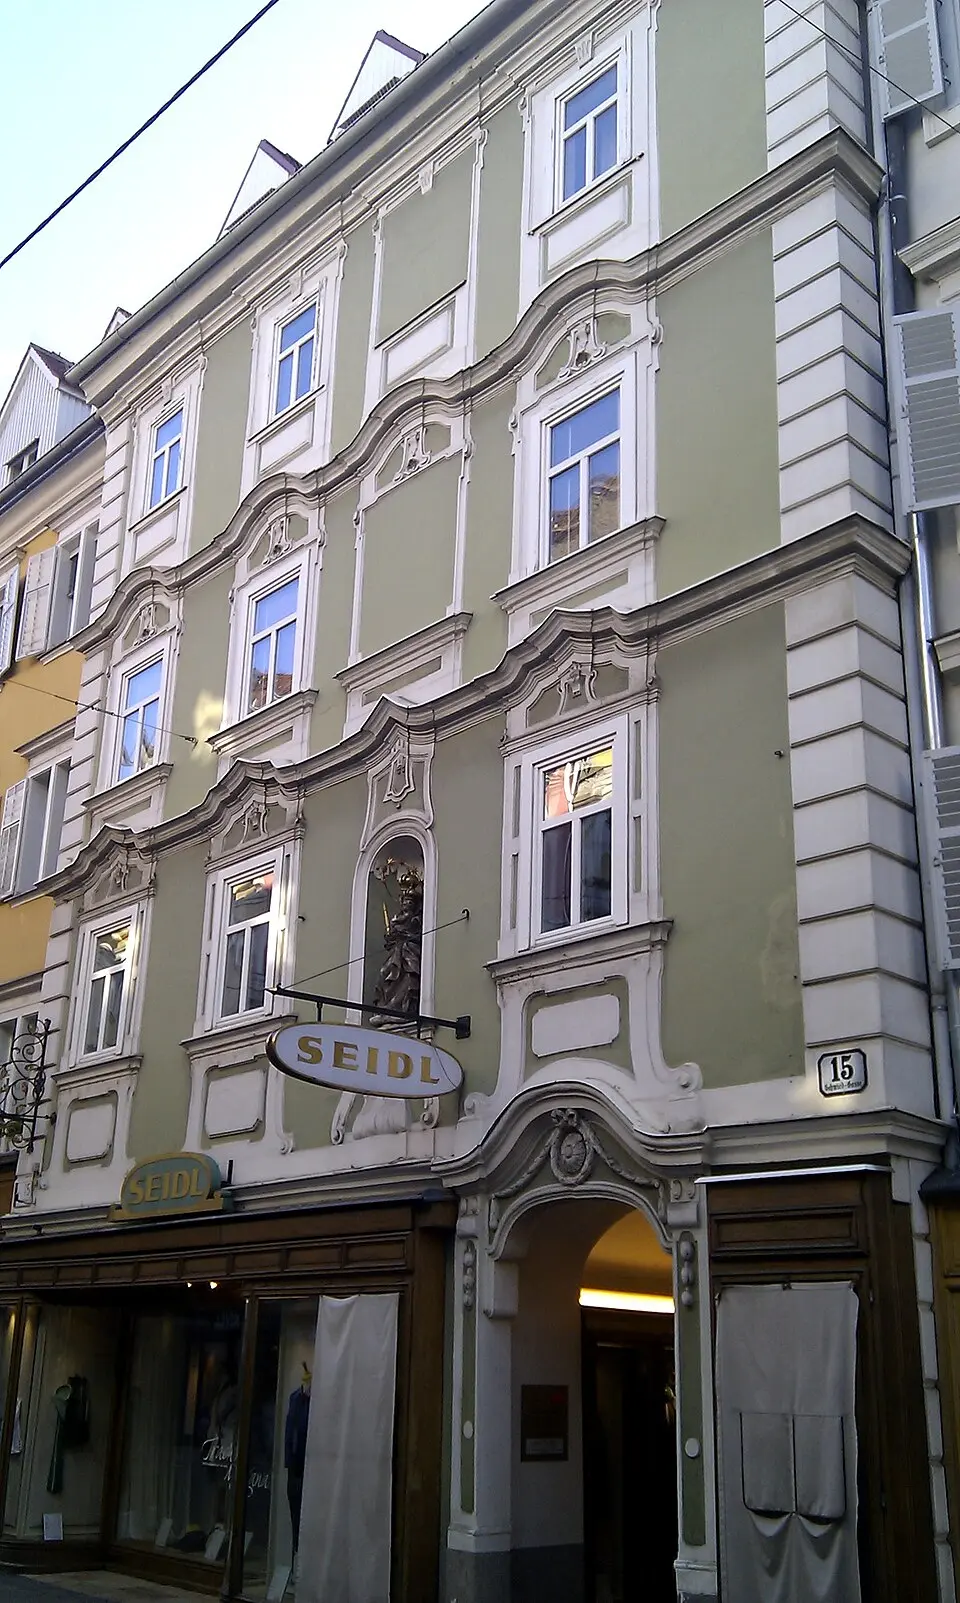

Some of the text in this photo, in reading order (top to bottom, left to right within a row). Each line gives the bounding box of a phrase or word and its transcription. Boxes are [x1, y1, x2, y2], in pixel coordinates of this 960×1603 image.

[297, 1036, 440, 1084] SEIDL
[830, 1054, 854, 1082] 15
[129, 1168, 203, 1205] SEIDL
